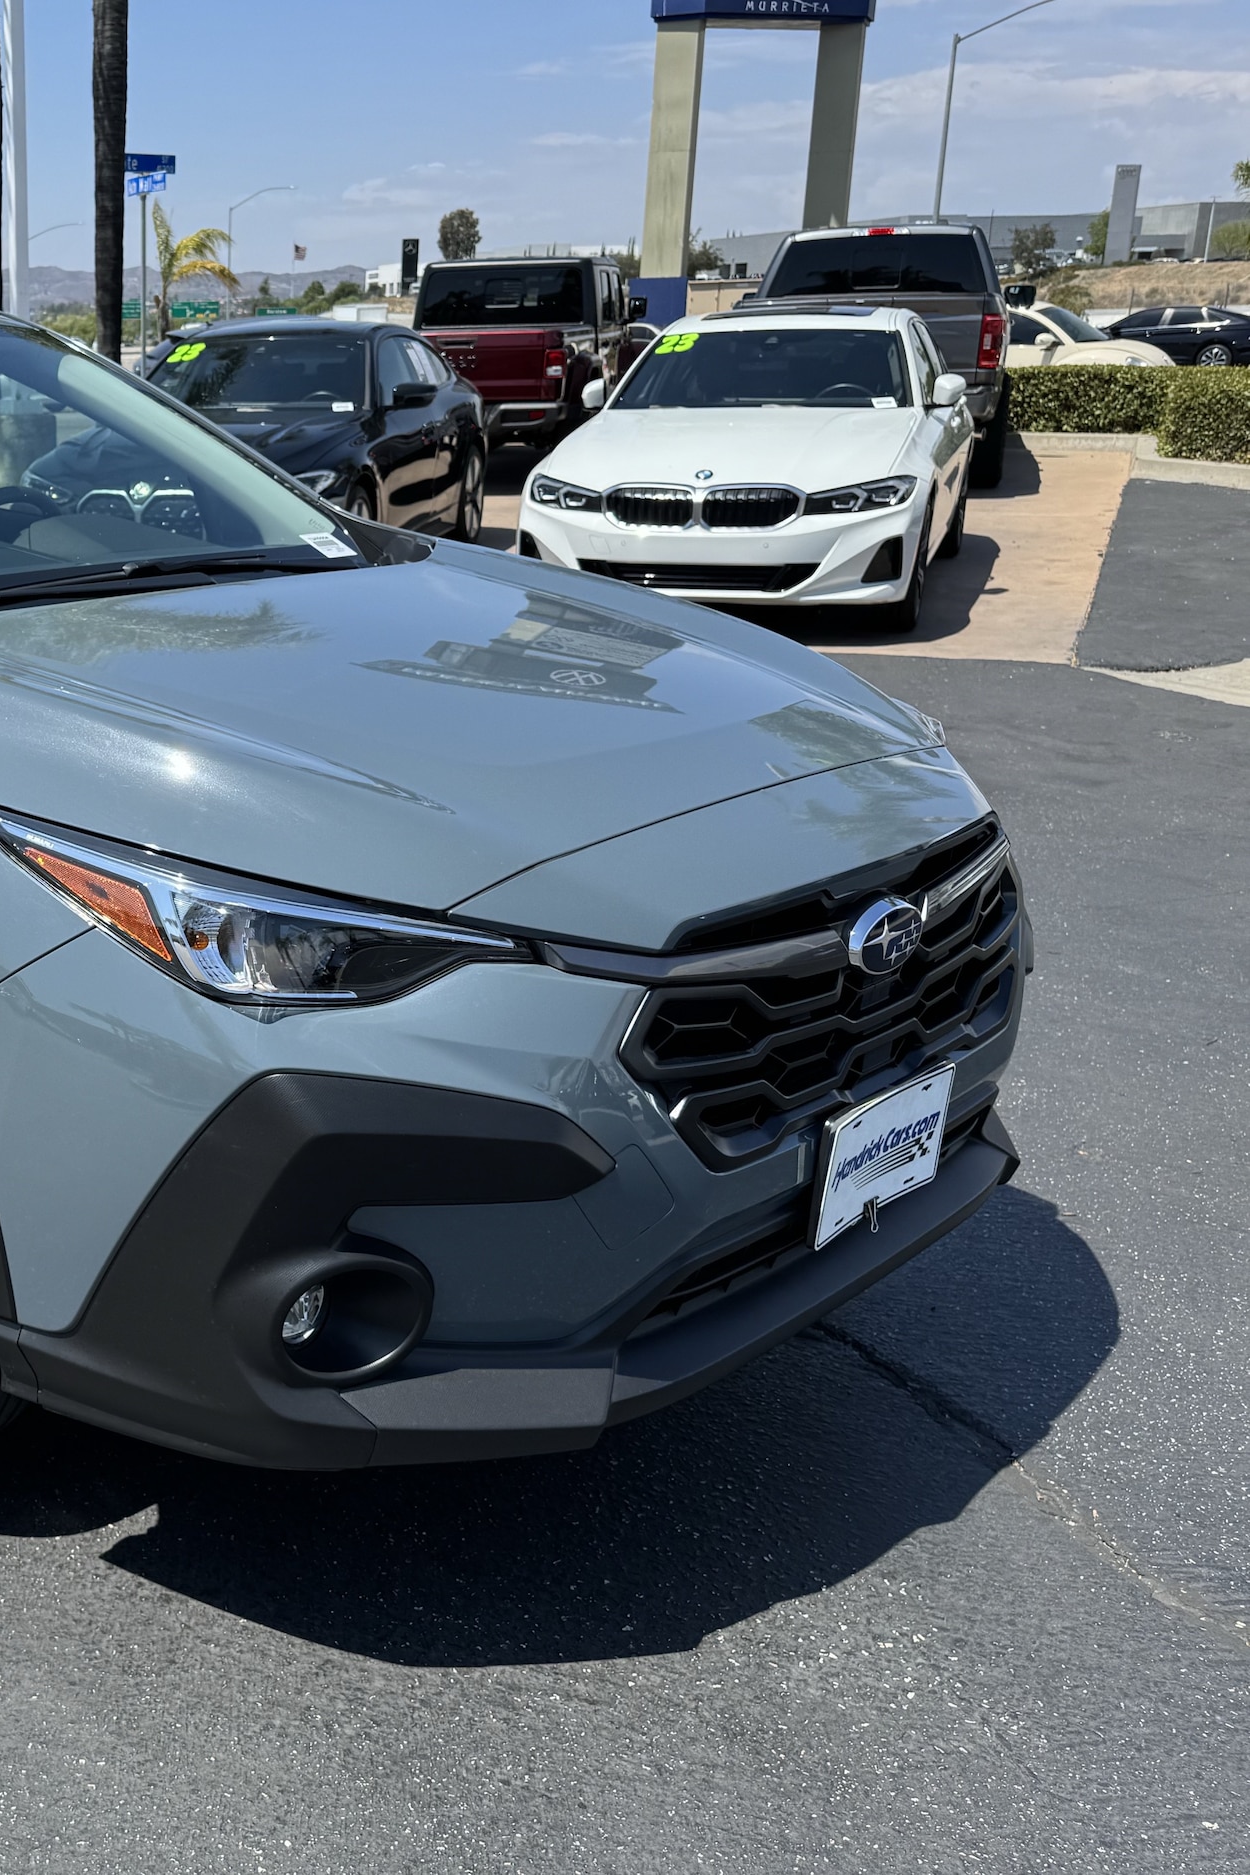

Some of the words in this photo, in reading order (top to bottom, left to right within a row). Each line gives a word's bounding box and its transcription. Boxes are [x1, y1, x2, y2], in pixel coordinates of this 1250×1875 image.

[745, 0, 830, 13] MURRIETA
[166, 342, 207, 364] 23
[654, 332, 699, 355] 23
